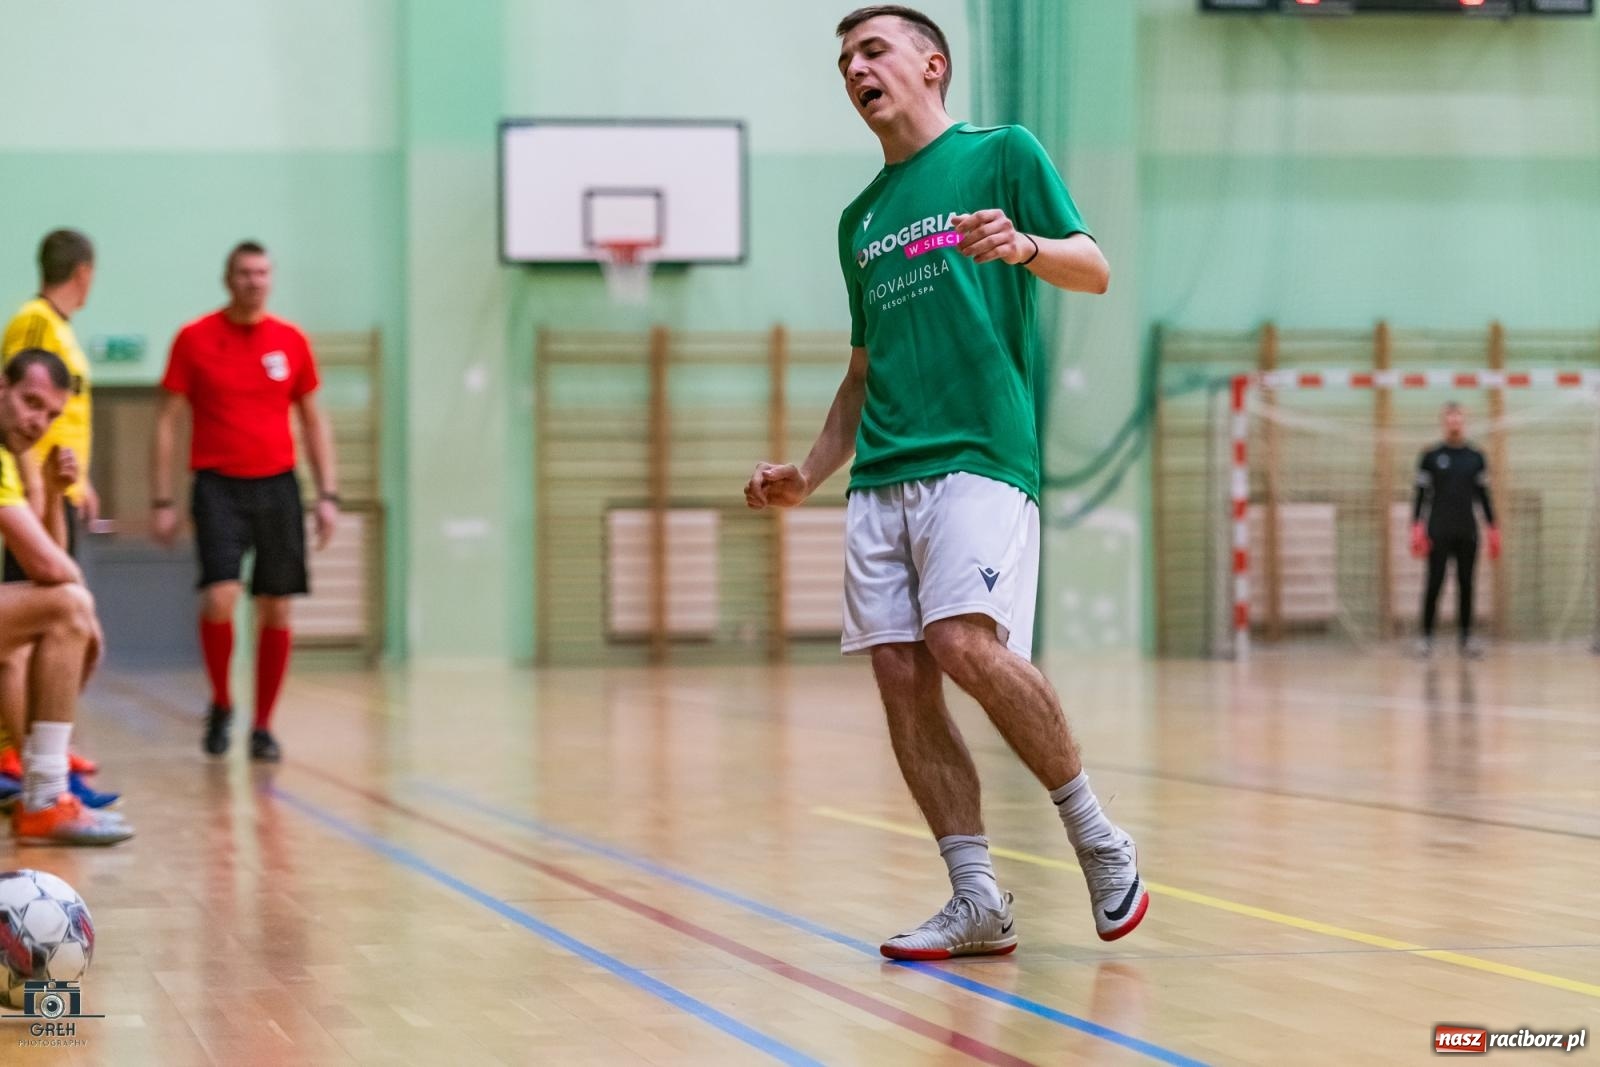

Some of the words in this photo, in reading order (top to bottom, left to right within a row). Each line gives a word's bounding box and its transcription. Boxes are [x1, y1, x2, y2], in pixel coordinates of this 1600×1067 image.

[909, 245, 919, 255] W
[925, 234, 960, 249] SIECI
[919, 285, 934, 296] SPA
